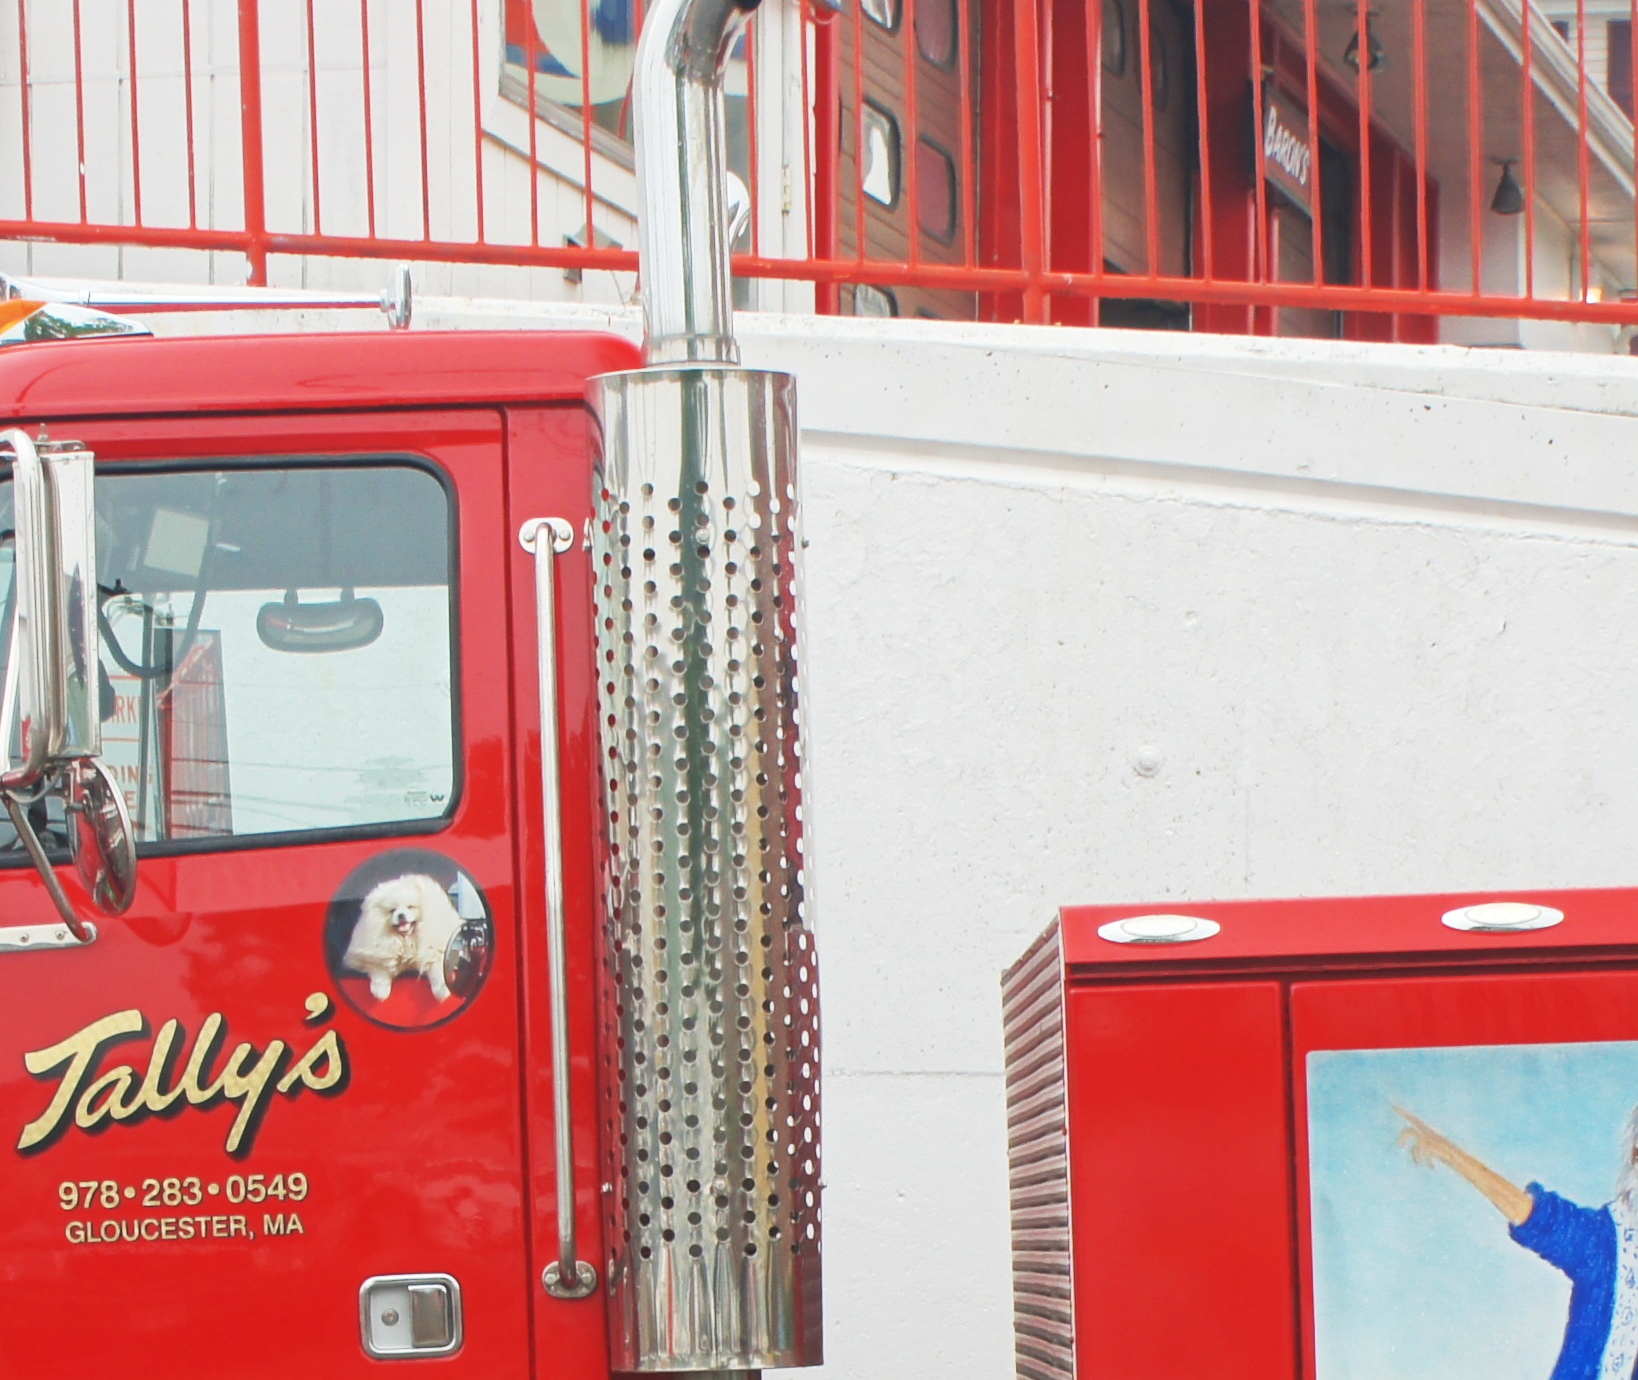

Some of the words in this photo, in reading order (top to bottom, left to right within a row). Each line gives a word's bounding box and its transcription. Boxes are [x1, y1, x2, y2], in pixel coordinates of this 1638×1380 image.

[16, 991, 346, 1158] Tally's
[65, 1215, 255, 1244] GLOUCESTER,
[263, 1213, 305, 1236] MA
